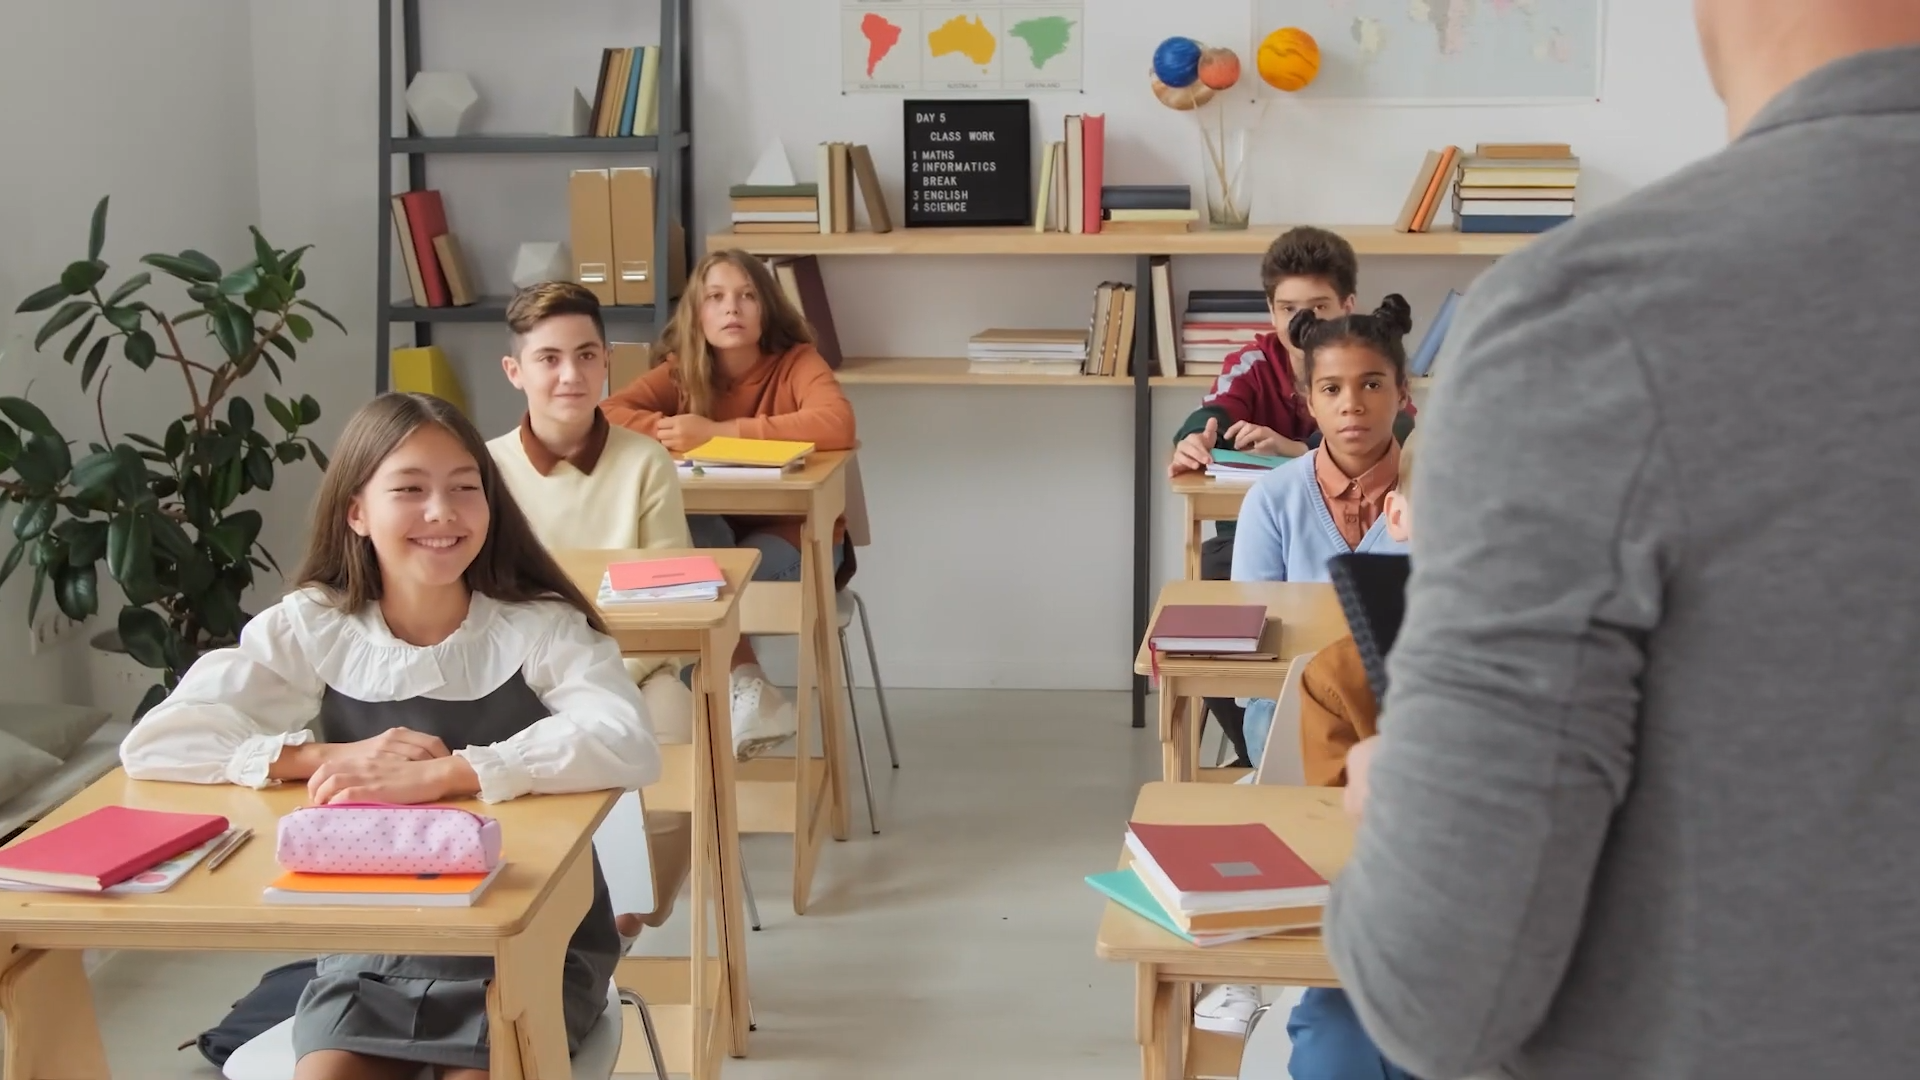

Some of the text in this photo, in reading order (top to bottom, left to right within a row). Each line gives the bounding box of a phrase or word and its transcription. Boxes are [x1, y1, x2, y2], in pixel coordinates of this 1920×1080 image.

[916, 113, 946, 123] DAY 5
[930, 131, 995, 141] CLASS WORK
[912, 150, 955, 160] 1 MATHS
[912, 161, 996, 172] 2 INFORMATICS
[923, 176, 957, 186] BREAK
[913, 190, 968, 201] 3 ENGLISH
[912, 202, 967, 212] 4 SCIENCE
